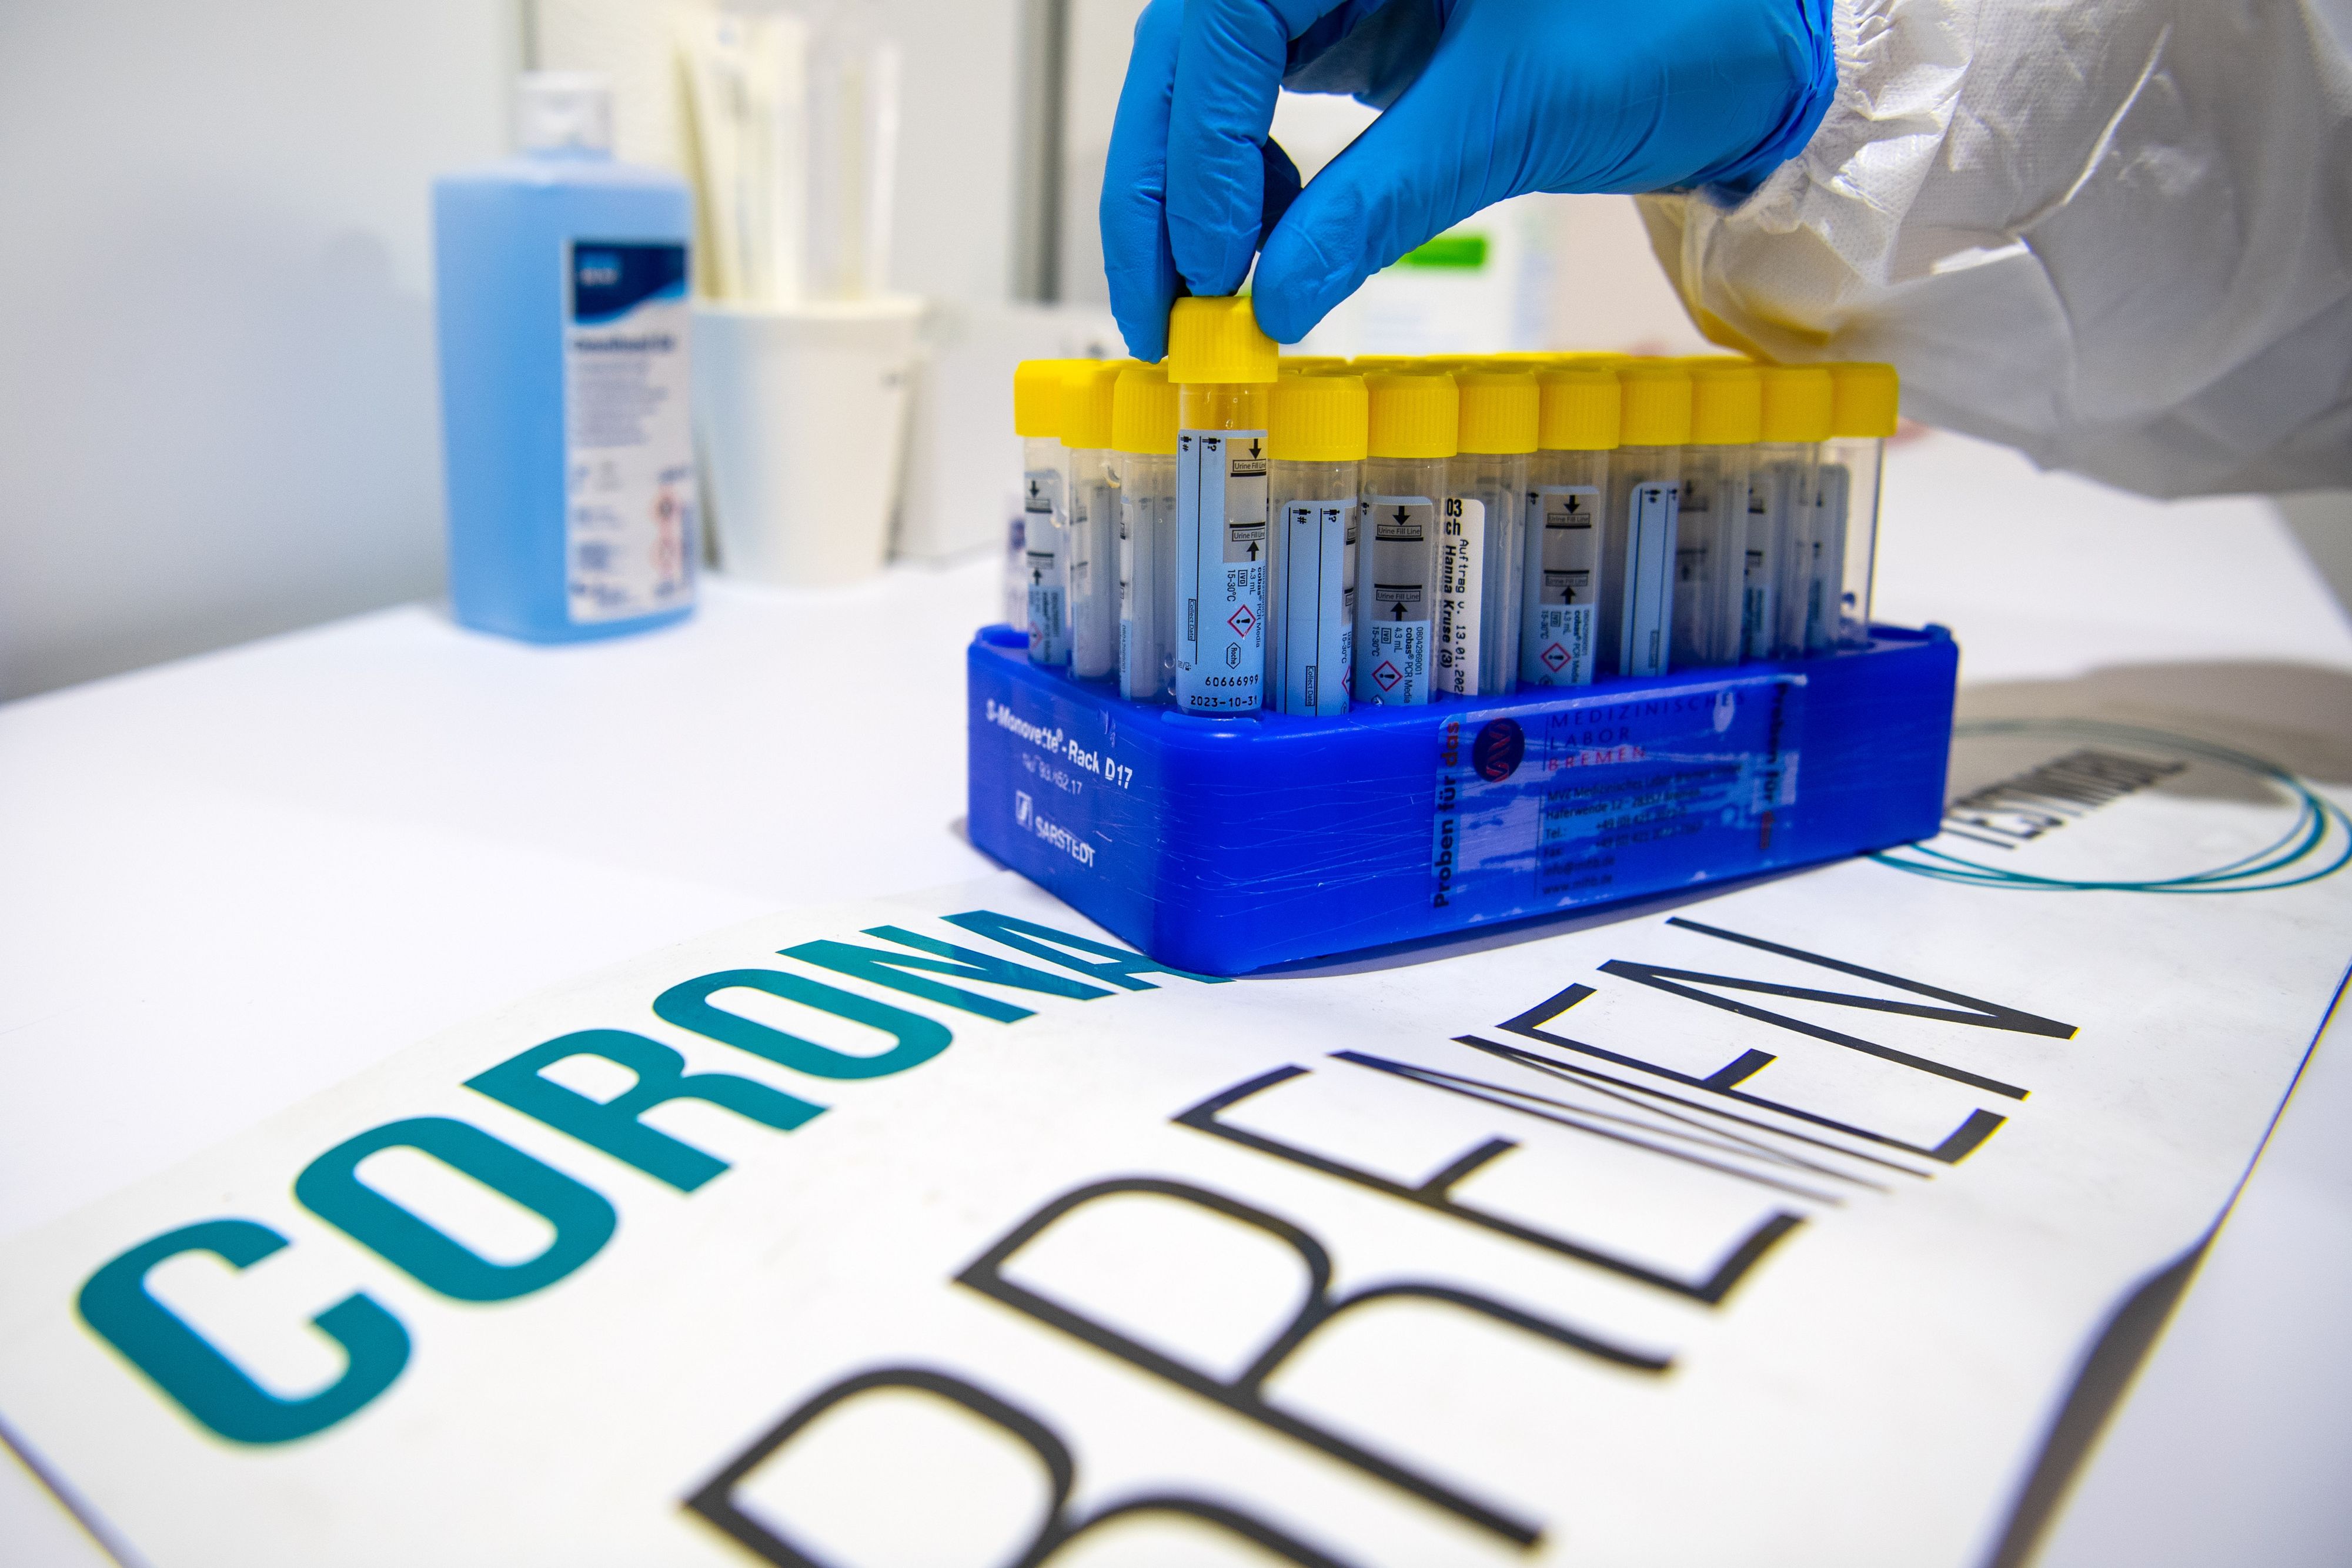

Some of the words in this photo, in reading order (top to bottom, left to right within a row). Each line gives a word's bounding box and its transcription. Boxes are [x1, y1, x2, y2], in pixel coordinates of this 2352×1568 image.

[1446, 499, 1462, 517] 03
[1445, 519, 1461, 536] ch
[1444, 545, 1456, 594] Hanna
[1456, 539, 1469, 593] Auftrag
[1227, 570, 1236, 601] 15-30°C
[1250, 582, 1255, 595] mL
[1456, 601, 1465, 614] v.
[1442, 600, 1454, 643] Kruse
[1371, 627, 1379, 657] 15-30°C
[1394, 641, 1401, 653] mL
[1415, 627, 1424, 675] 08042969001
[1405, 661, 1413, 678] PCR
[1440, 649, 1452, 668] (3)
[1205, 674, 1258, 687] 60666999
[1404, 680, 1412, 704] Media
[1190, 695, 1258, 707] 2023-10-31
[1441, 721, 1460, 767] das
[1551, 727, 1629, 750] LABOR
[1548, 745, 1646, 772] BREMEN
[1438, 775, 1456, 813] für
[1035, 815, 1096, 868] SARSTEDT
[1434, 818, 1454, 908] Proben
[75, 910, 1237, 1447] CORONA
